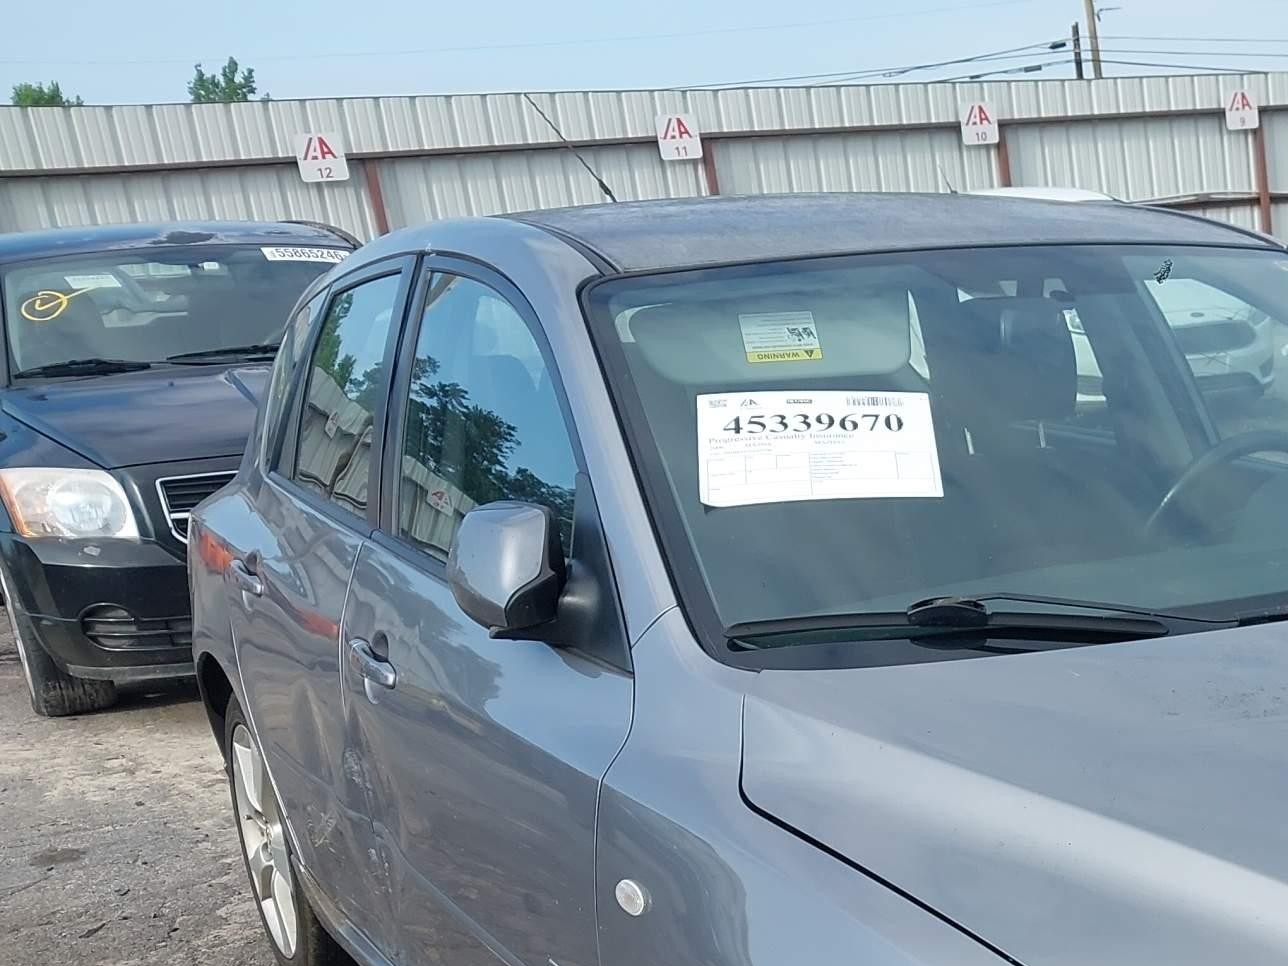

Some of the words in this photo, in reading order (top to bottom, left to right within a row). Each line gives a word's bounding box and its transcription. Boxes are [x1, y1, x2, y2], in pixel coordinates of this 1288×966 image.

[976, 132, 988, 142] 10
[674, 146, 688, 157] 11
[316, 167, 335, 178] 12
[757, 352, 800, 360] WARNING
[723, 413, 904, 434] 45339670
[708, 434, 763, 444] Progressive
[765, 432, 806, 440] Casualty
